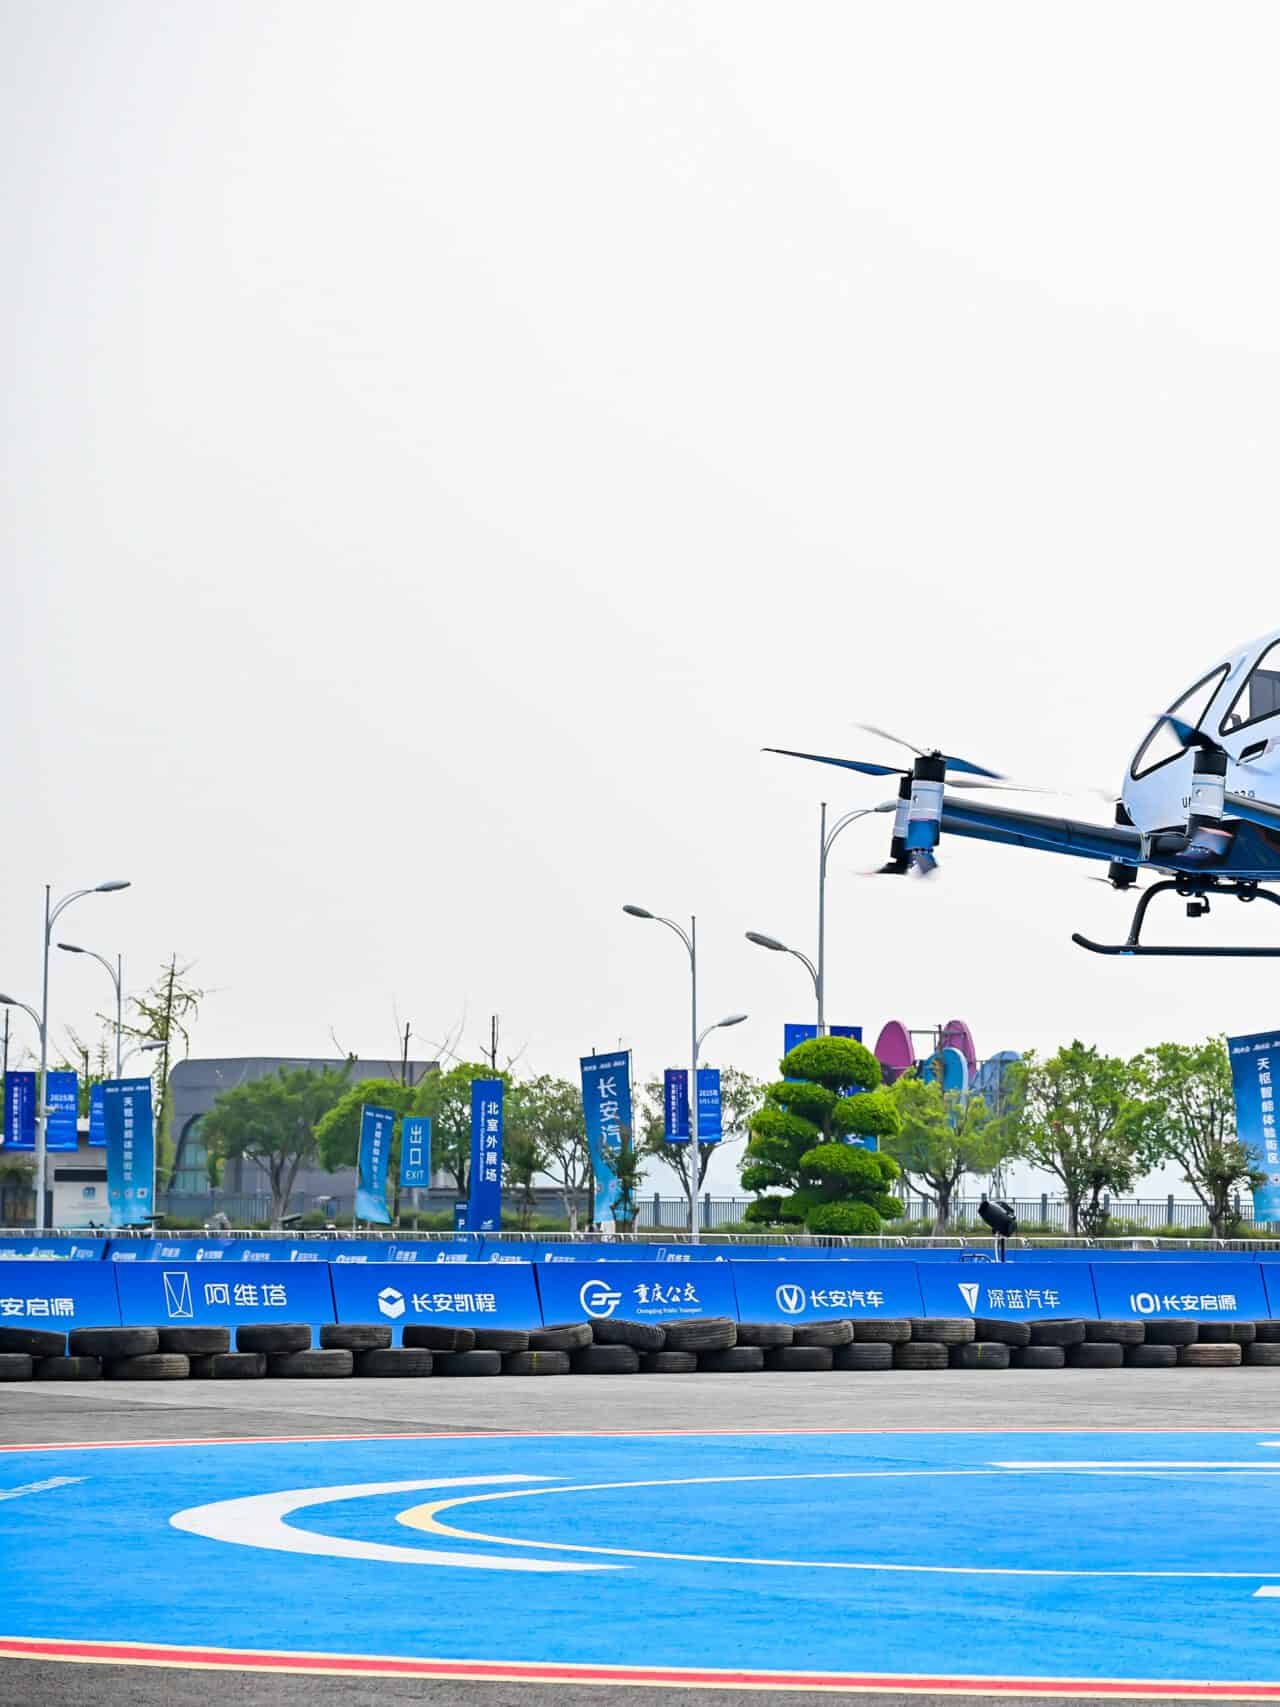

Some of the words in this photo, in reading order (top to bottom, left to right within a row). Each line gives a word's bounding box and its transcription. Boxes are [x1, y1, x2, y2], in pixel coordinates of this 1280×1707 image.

[597, 1076, 623, 1150] 长安汽
[1257, 1057, 1280, 1164] 天枢智能体验街区
[410, 1124, 423, 1165] 出口
[485, 1101, 499, 1182] 北室外展场
[406, 1170, 425, 1181] EXIT
[204, 1282, 288, 1307] 阿维塔
[412, 1292, 497, 1313] 长安凯程
[632, 1283, 700, 1304] 重庆公交
[810, 1289, 885, 1309] 长安汽车
[987, 1288, 1061, 1310] 深蓝汽车
[1162, 1294, 1237, 1311] 长安启源
[0, 1297, 75, 1317] 安启源
